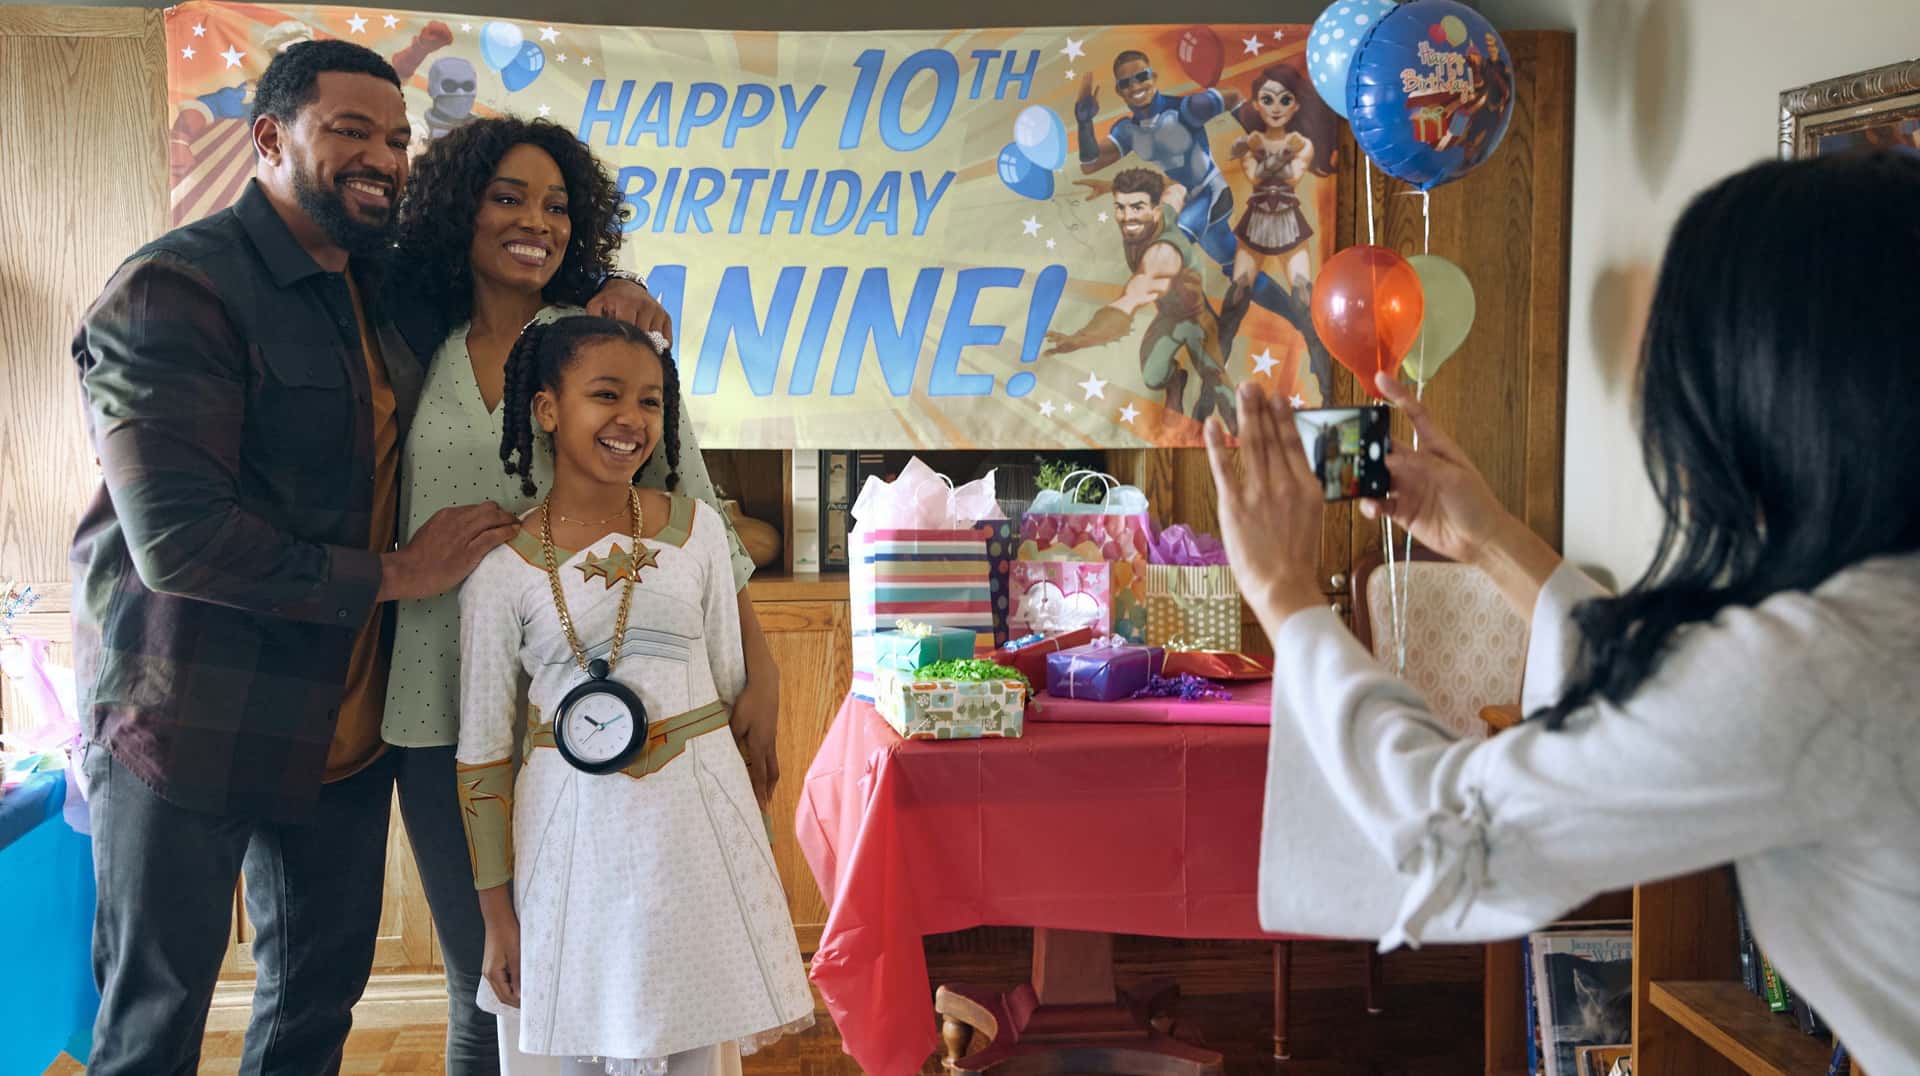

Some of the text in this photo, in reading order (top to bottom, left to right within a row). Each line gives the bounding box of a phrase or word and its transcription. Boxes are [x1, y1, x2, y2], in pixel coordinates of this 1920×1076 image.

[577, 48, 1041, 151] HAPPY 10TH
[1417, 41, 1466, 77] Happy
[617, 165, 957, 236] BIRTHDAY
[640, 264, 1068, 398] ANINE!
